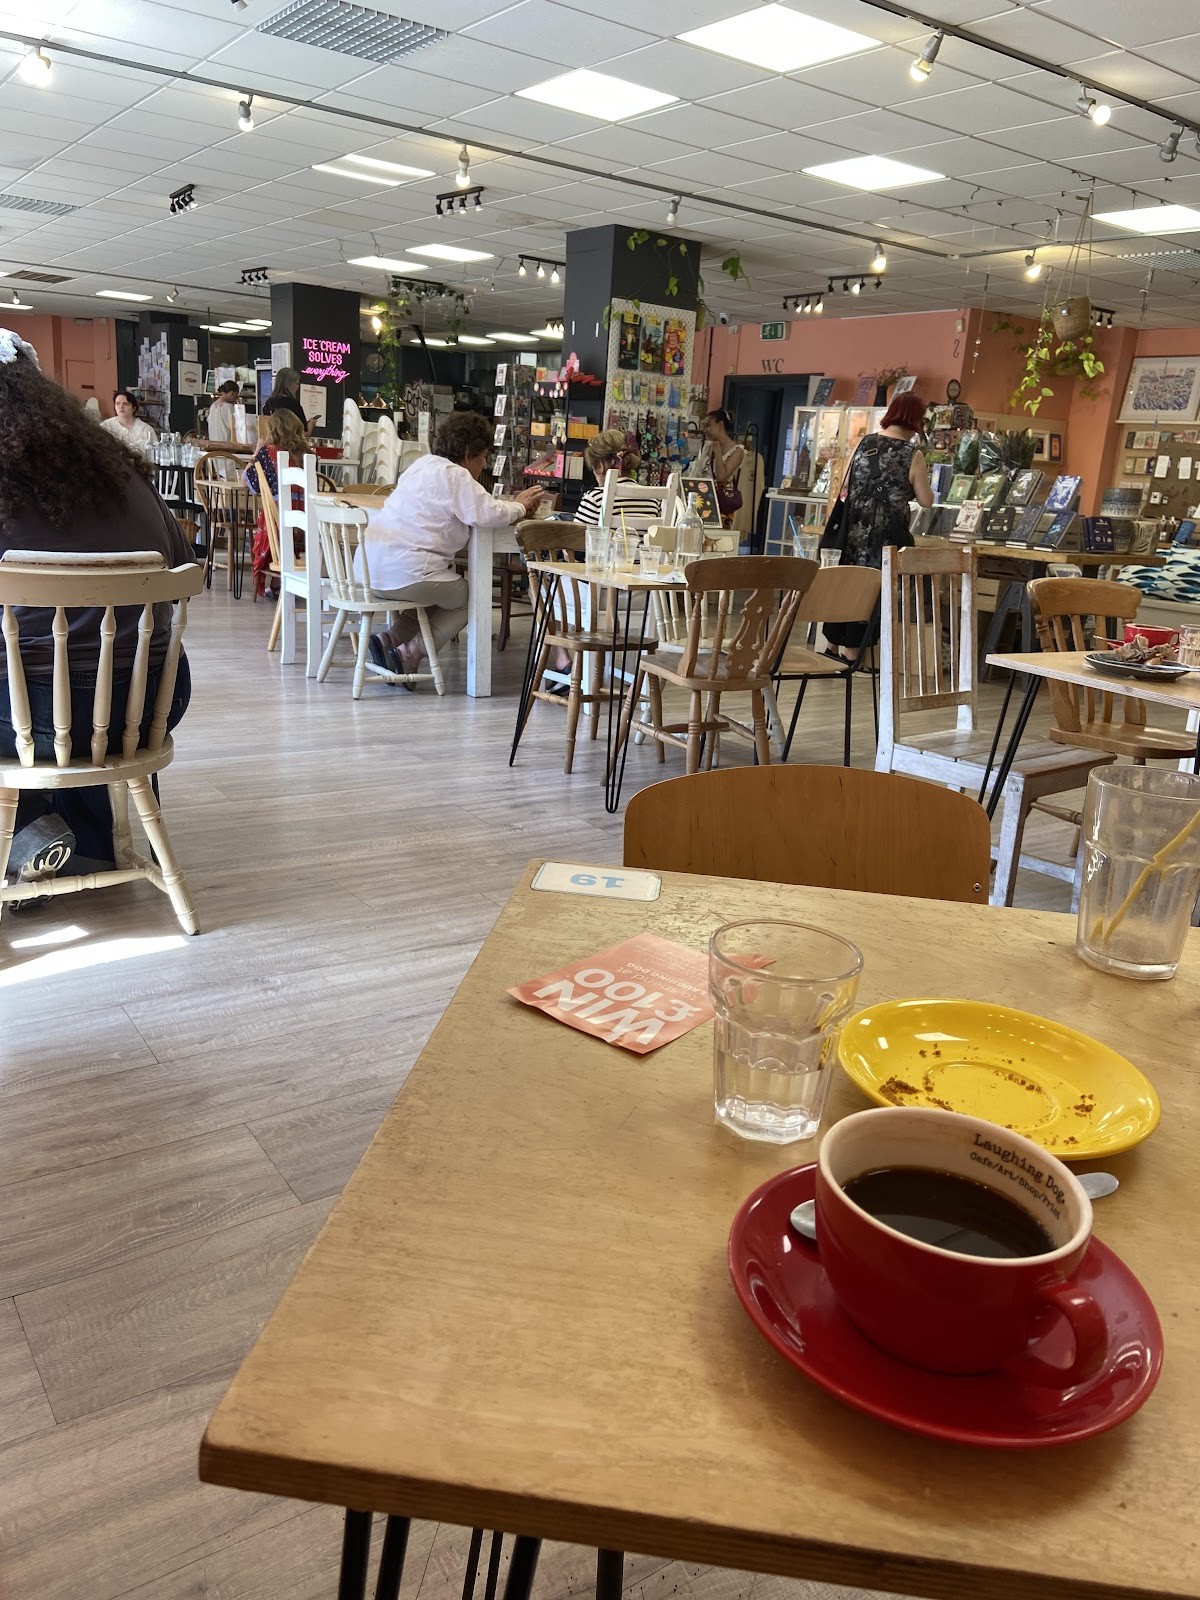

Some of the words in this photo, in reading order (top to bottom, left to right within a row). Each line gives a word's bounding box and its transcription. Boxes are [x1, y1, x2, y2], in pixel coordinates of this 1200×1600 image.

[302, 338, 318, 350] ICE
[320, 340, 351, 354] CREAM
[308, 351, 343, 365] SOLVES
[761, 358, 785, 374] WC
[301, 365, 351, 384] everything
[616, 966, 630, 978] at
[626, 962, 649, 974] DOG
[631, 974, 680, 994] spend
[650, 970, 707, 996] LAUGHING
[573, 967, 703, 1023] £100
[680, 990, 697, 1001] to
[532, 977, 666, 1046] WIN
[973, 1132, 1044, 1183] Laughing
